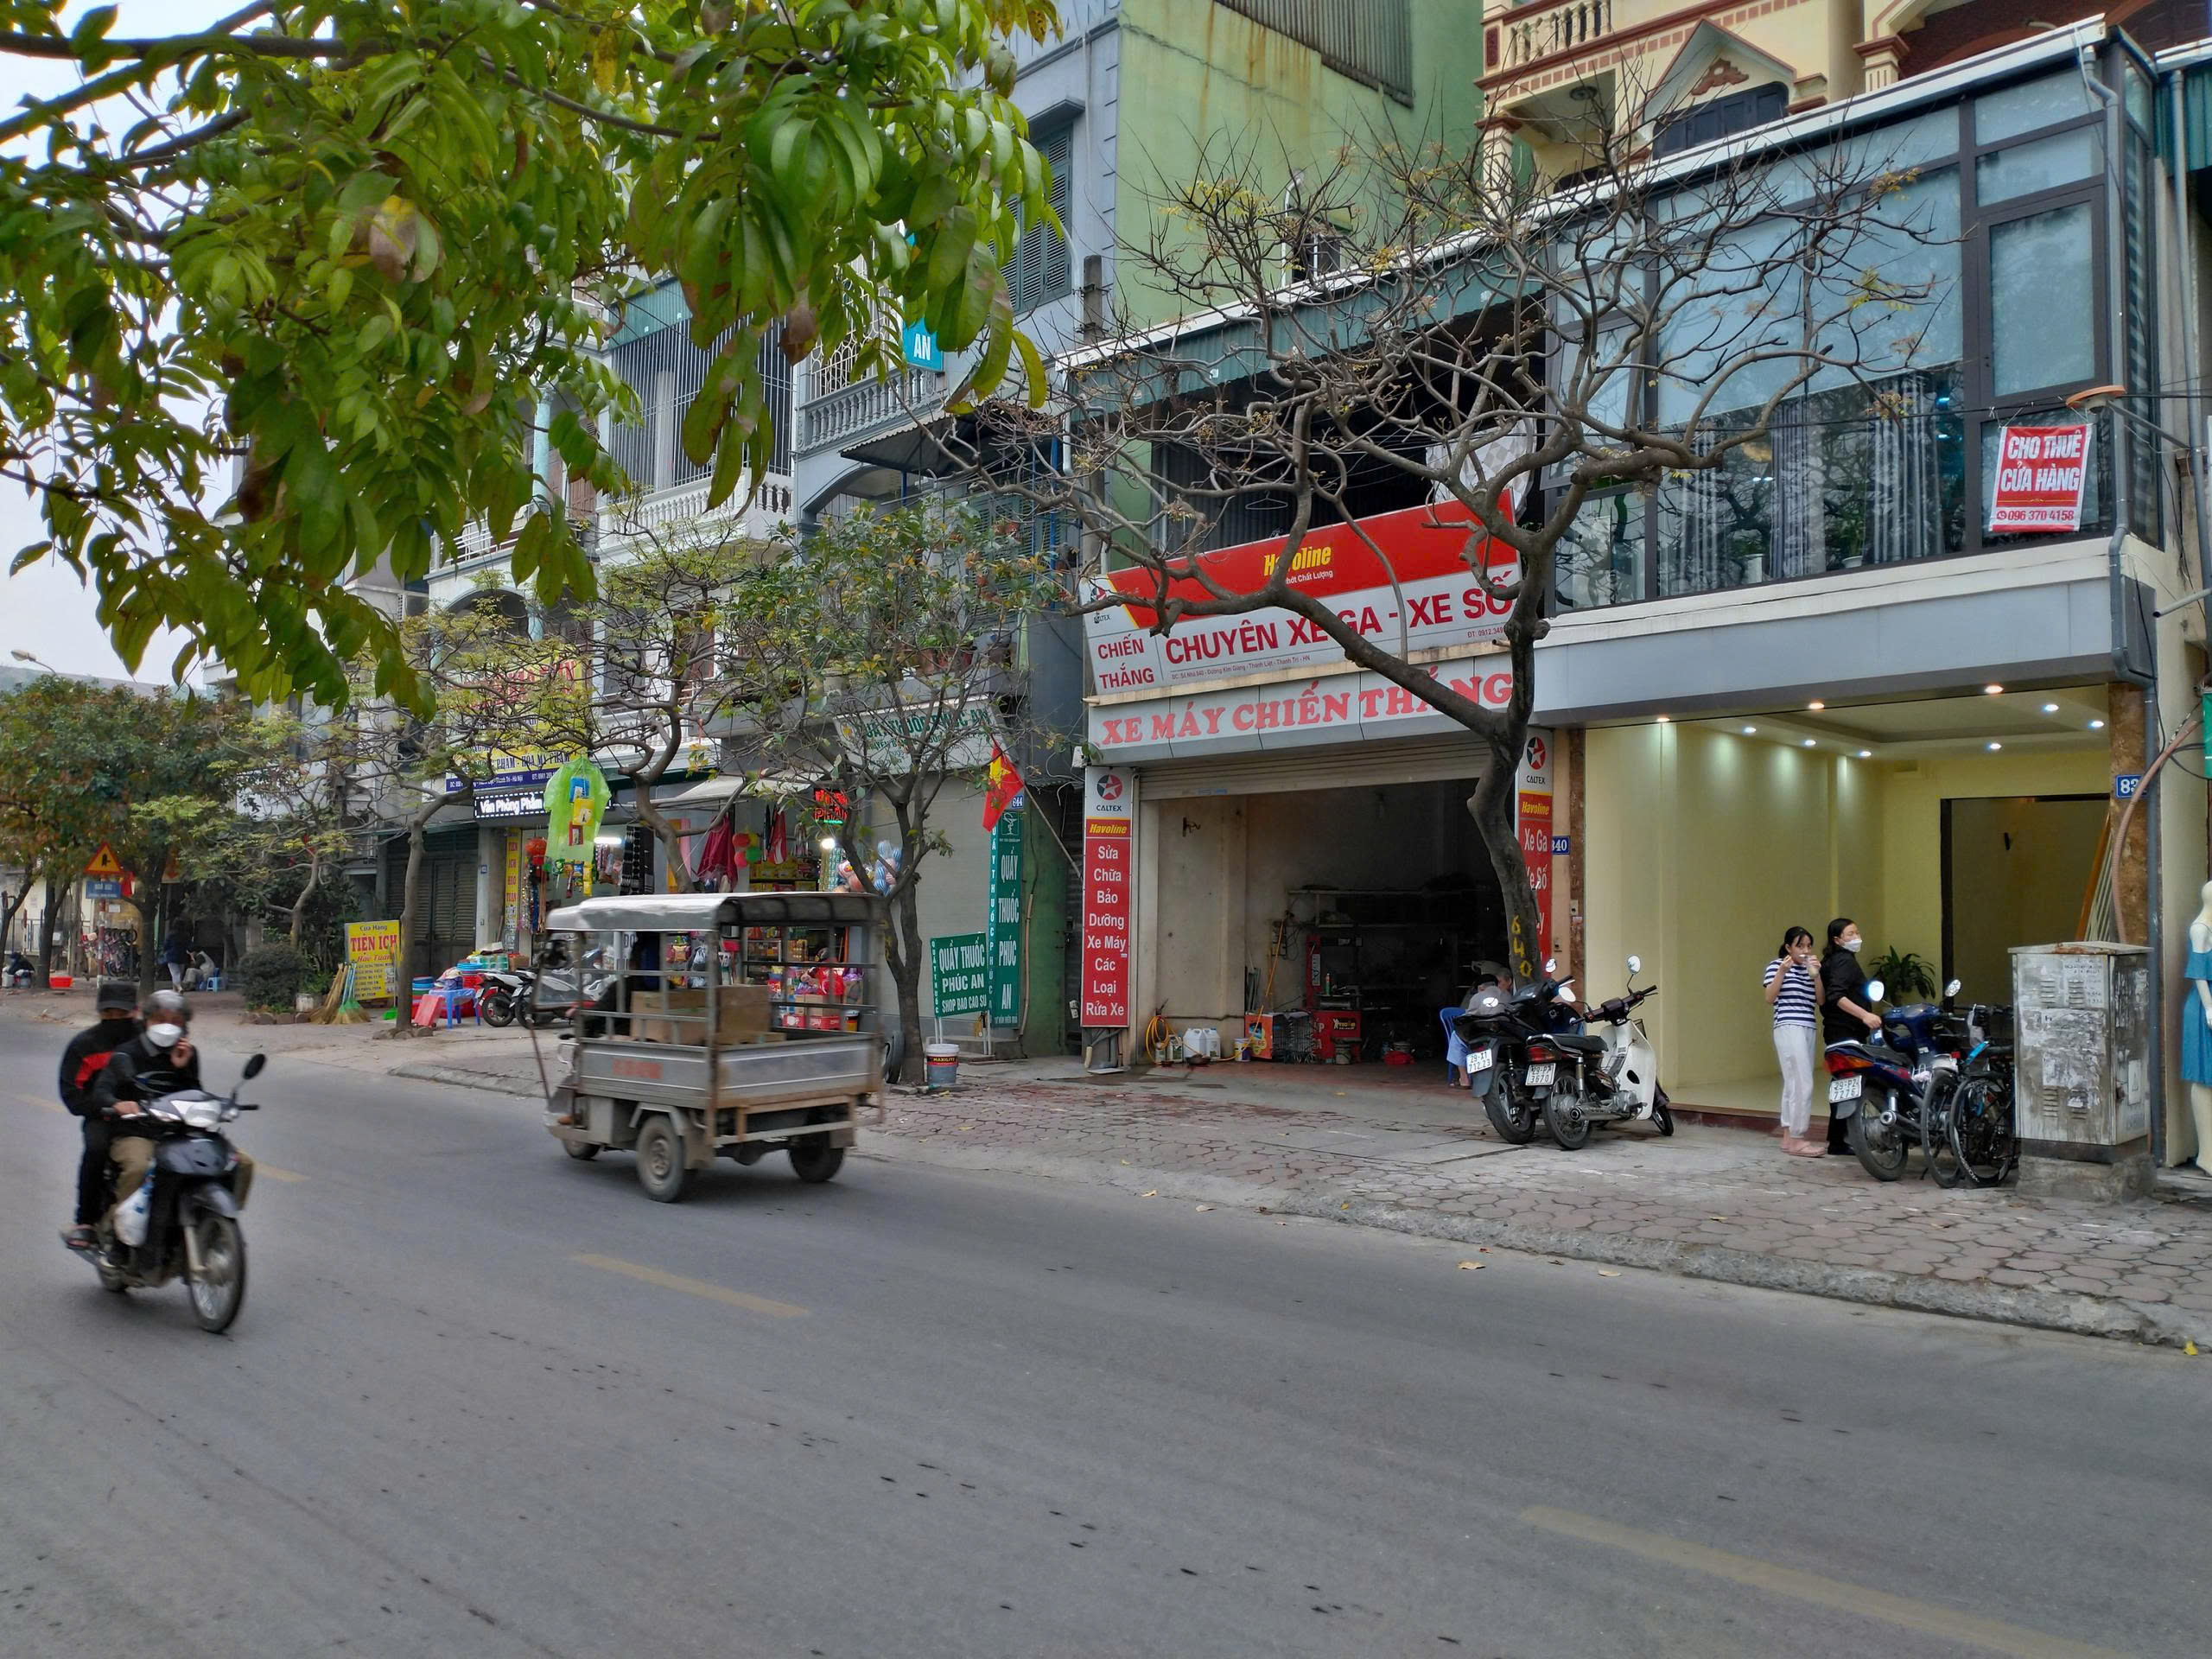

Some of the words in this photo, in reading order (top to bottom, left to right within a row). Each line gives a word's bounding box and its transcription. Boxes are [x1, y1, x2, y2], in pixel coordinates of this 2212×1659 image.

[913, 333, 931, 360] AN
[2007, 435, 2040, 460] CHO
[2043, 429, 2082, 459] THUÊ
[1999, 461, 2032, 492] CỬA
[2035, 461, 2080, 492] HÀNG
[2007, 511, 2026, 521] 096
[2027, 511, 2047, 521] 370
[2049, 510, 2074, 521] 4158
[1263, 546, 1332, 576] Holine
[1297, 573, 1313, 582] Chất
[1165, 620, 1279, 664] CHUYÊN
[1407, 593, 1453, 628] XE
[1097, 633, 1145, 660] CHIẾN
[1099, 663, 1154, 690] THẮNG
[1103, 716, 1143, 745] XE
[1151, 701, 1225, 741] MÁY
[1231, 680, 1350, 731] CHIẾN
[1358, 664, 1513, 718] THNG
[1526, 775, 1546, 785] CALTEX
[480, 798, 495, 814] Văn
[495, 798, 520, 816] Phòng
[520, 791, 543, 811] Phẩm
[1522, 801, 1549, 816] Havoline
[1090, 823, 1128, 834] Havoline
[1524, 828, 1535, 851] Xe
[1536, 829, 1548, 853] Ga
[1097, 845, 1119, 860] Sửa
[1093, 868, 1122, 881] Chữa
[998, 888, 1019, 924] THUỐC
[1096, 888, 1118, 904] Bảo
[1089, 912, 1125, 930] Dưỡng
[960, 936, 985, 969] THUỐC
[998, 935, 1017, 967] PHÚC
[1087, 935, 1102, 949] Xe
[1104, 935, 1127, 952] Máy
[1095, 957, 1116, 971] Các
[942, 973, 969, 993] PHÚC
[970, 973, 984, 989] AN
[1093, 981, 1116, 996] Loại
[942, 998, 957, 1014] SHOP
[957, 997, 968, 1011] BAO
[968, 995, 979, 1009] CAO
[979, 994, 987, 1007] SU
[1001, 983, 1012, 1009] AN
[1110, 1002, 1124, 1016] Xe
